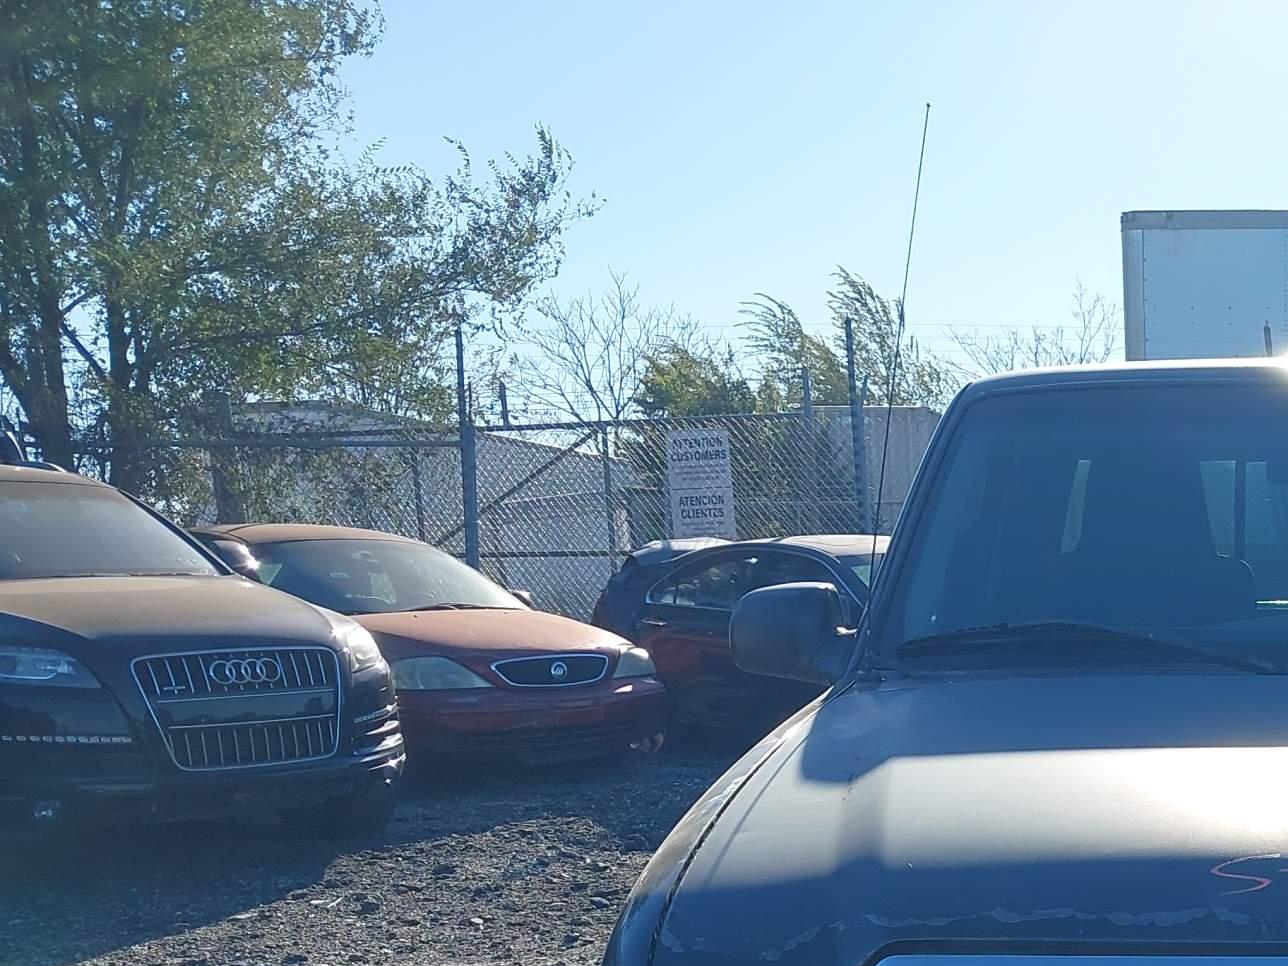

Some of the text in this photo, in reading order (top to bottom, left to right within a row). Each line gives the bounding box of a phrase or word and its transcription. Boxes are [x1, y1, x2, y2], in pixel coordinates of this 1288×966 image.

[672, 437, 723, 450] ATTENTION
[670, 449, 727, 462] CUSTOMERS
[681, 508, 724, 519] CLIENTES
